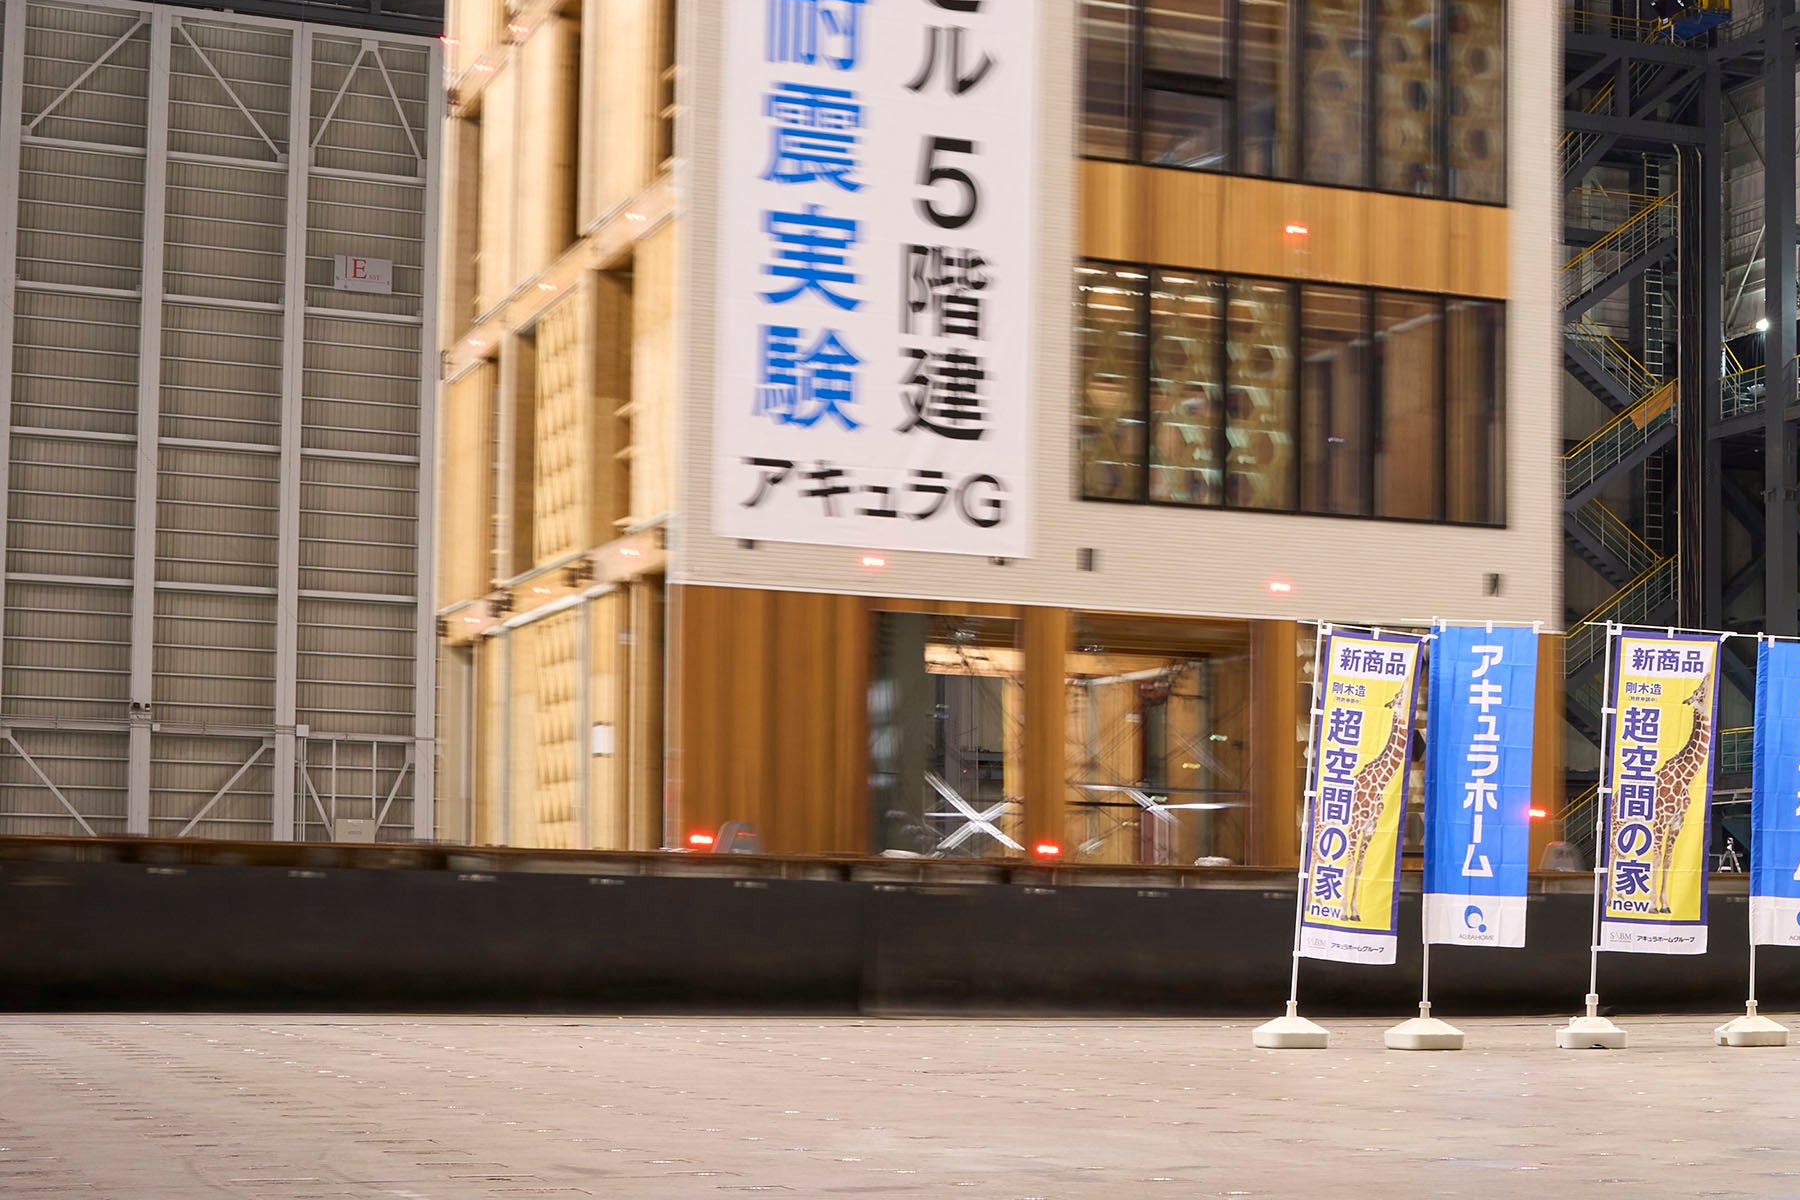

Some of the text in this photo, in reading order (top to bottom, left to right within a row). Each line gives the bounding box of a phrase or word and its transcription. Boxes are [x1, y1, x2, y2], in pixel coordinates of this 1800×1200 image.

[738, 455, 1010, 529] アキュラG
[1340, 647, 1407, 677] 新商品
[1632, 647, 1705, 673] 新商品
[1331, 681, 1367, 698] 剛木造
[1625, 681, 1662, 696] 剛木造
[1461, 645, 1504, 878] アキュラホーム
[1314, 708, 1363, 900] 超空間の家
[1615, 707, 1660, 894] 超空間の家
[1311, 904, 1341, 919] new
[1612, 899, 1650, 912] new
[1636, 935, 1695, 943] アキュラホームグループ
